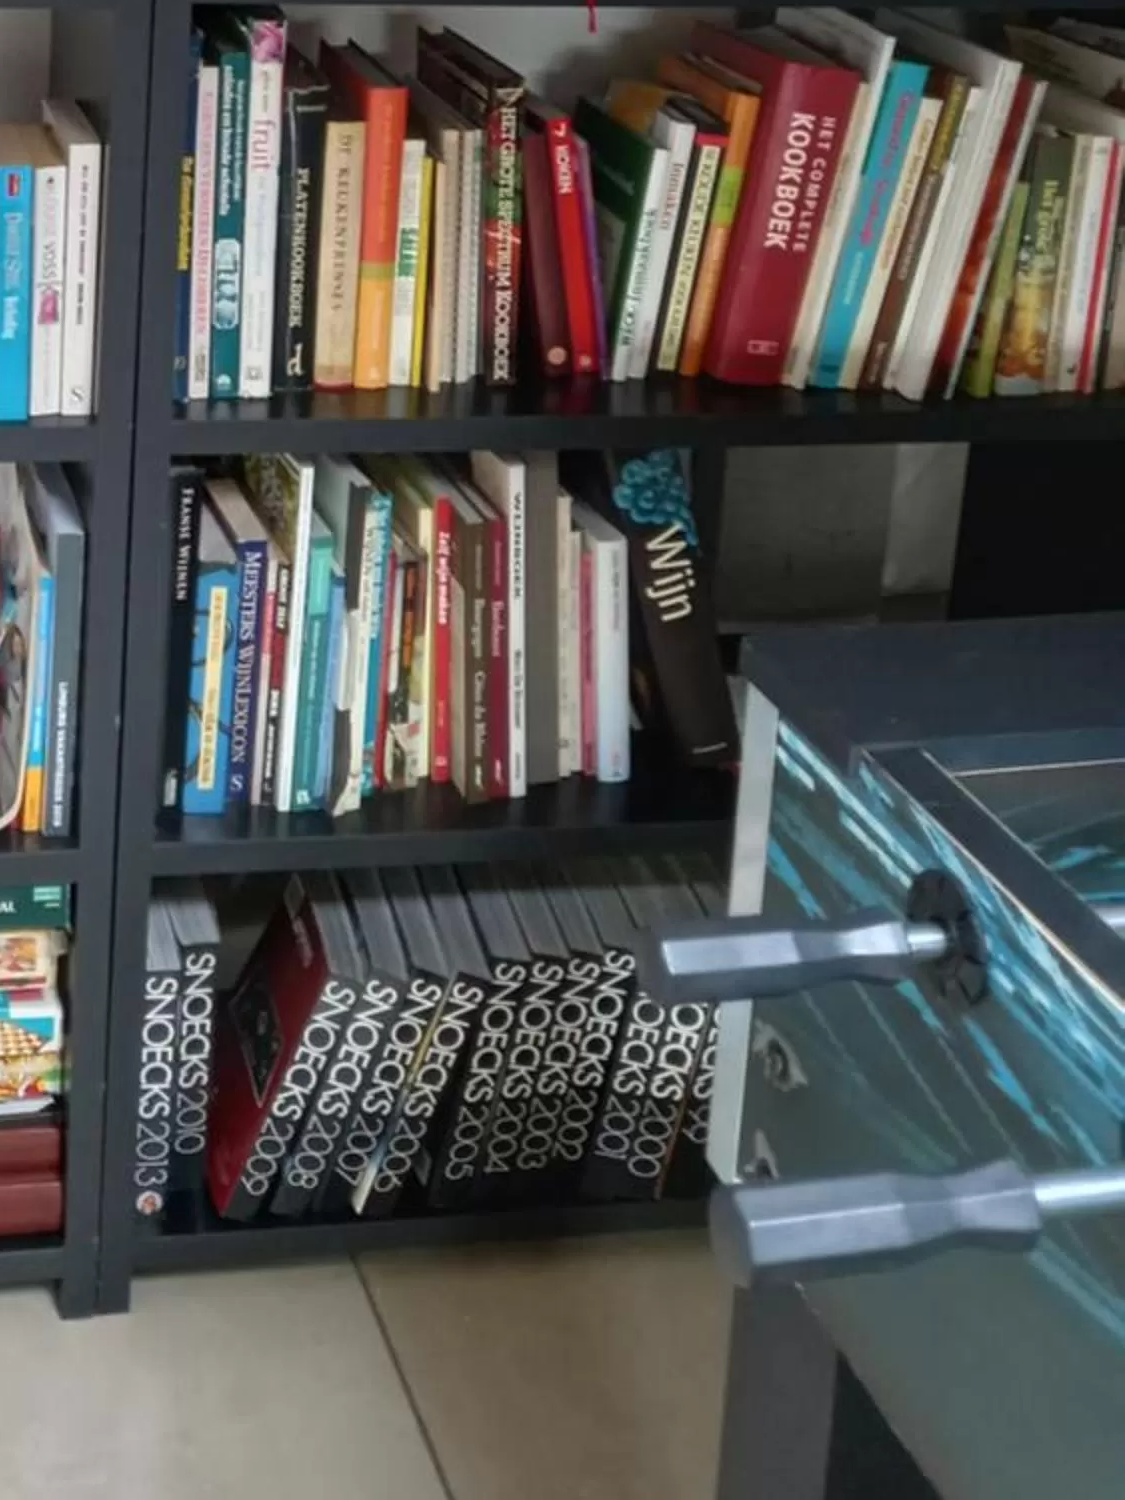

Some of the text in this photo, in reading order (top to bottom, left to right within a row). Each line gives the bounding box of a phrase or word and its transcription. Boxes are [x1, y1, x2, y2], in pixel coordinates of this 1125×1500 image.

[250, 119, 277, 173] fruit
[556, 144, 572, 194] KOKEN
[762, 112, 816, 250] KOOKBOEK
[792, 116, 837, 253] HET COMPLETE
[493, 290, 514, 380] KOOKBOEK
[177, 488, 195, 540] FRANSE
[644, 524, 696, 623] Wijn
[231, 551, 263, 763] MEESTERS WIJNLEXICON
[133, 976, 176, 1187] SNOECKS 2013
[174, 952, 216, 1155] SNOECKS 2010
[239, 980, 356, 1196] SNOECKS 2009
[286, 980, 398, 1190] SNOECKS 2008
[334, 978, 442, 1187] SNOECKS 2007
[374, 981, 484, 1193] SNOECKS 2006
[445, 963, 526, 1180] SNOECKS 2005
[483, 961, 564, 1173] SNOECKS 2004
[516, 957, 601, 1170] SNOECKS 2003
[551, 950, 636, 1161] SNOECKS 2002
[612, 992, 665, 1096] OECKS
[626, 1002, 708, 1178] OECKS 2000
